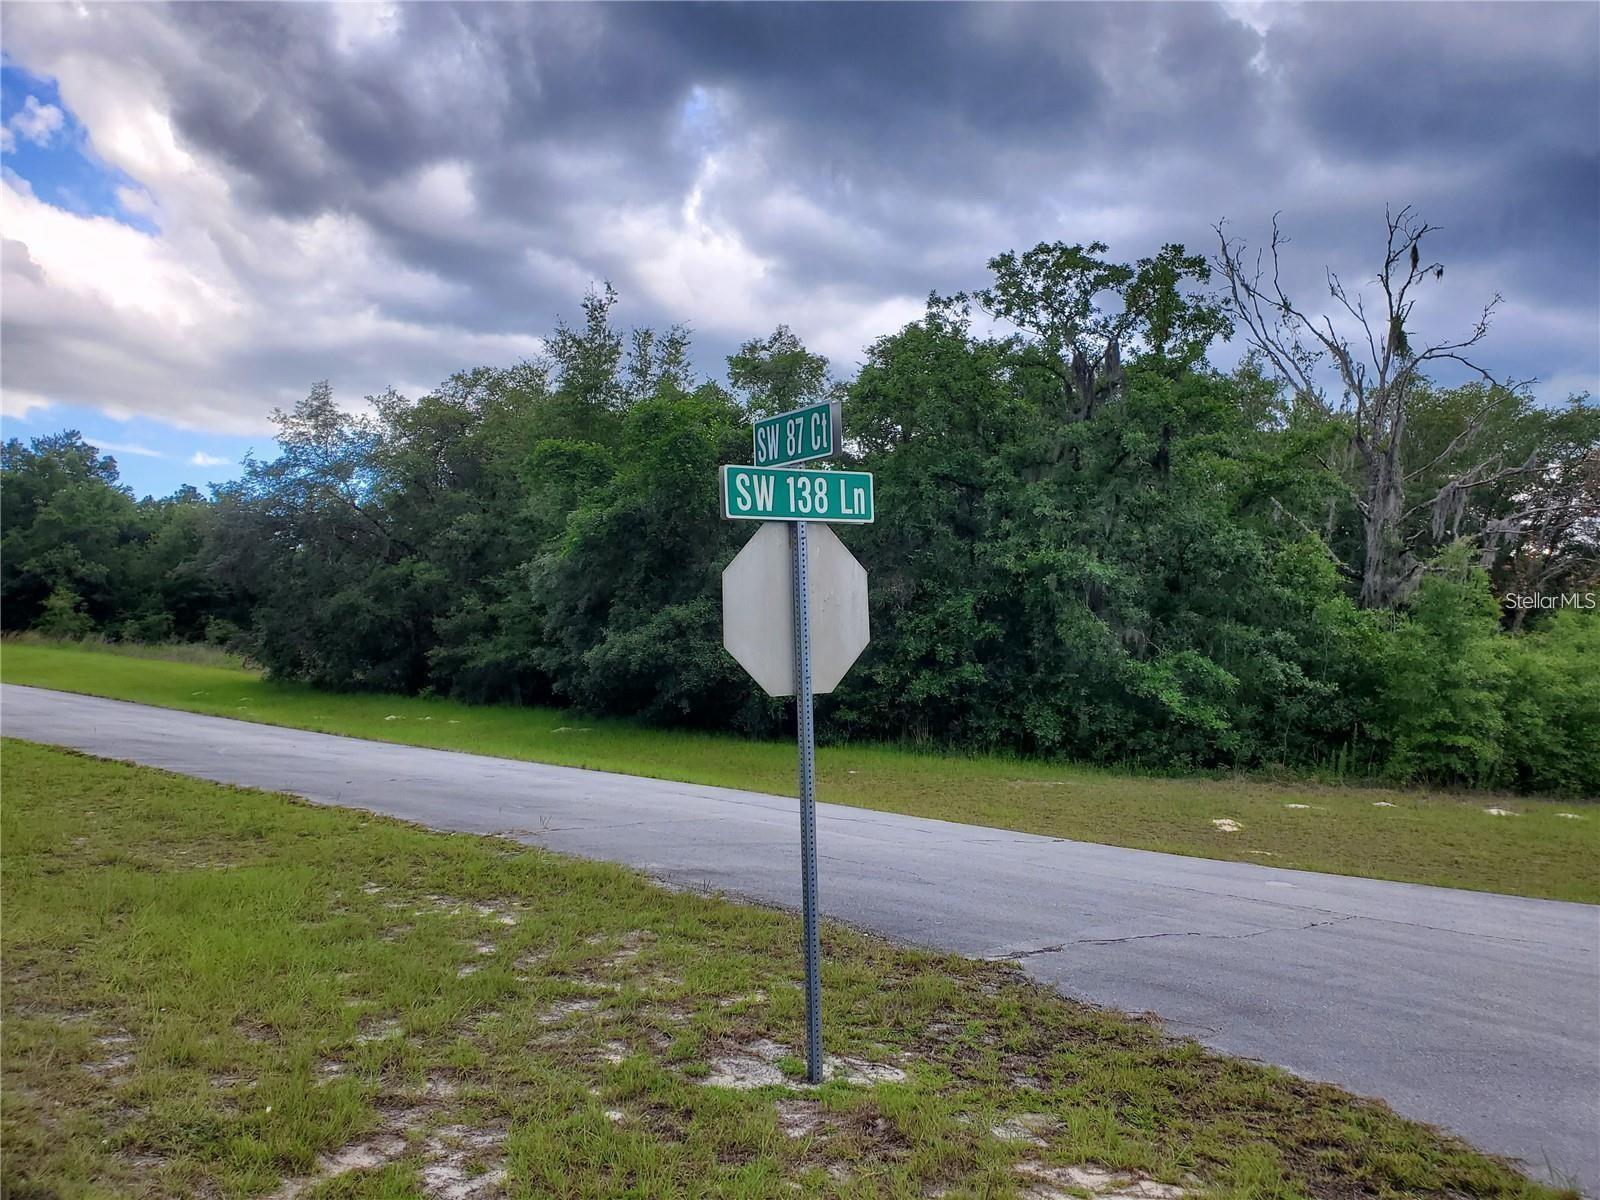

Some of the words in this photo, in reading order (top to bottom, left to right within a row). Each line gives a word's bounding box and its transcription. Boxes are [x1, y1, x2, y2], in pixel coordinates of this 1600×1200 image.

[757, 424, 779, 463] SW
[787, 417, 804, 456] 87
[811, 412, 827, 451] Ct
[735, 473, 775, 511] SW
[786, 476, 828, 514] 138
[840, 479, 866, 515] Ln
